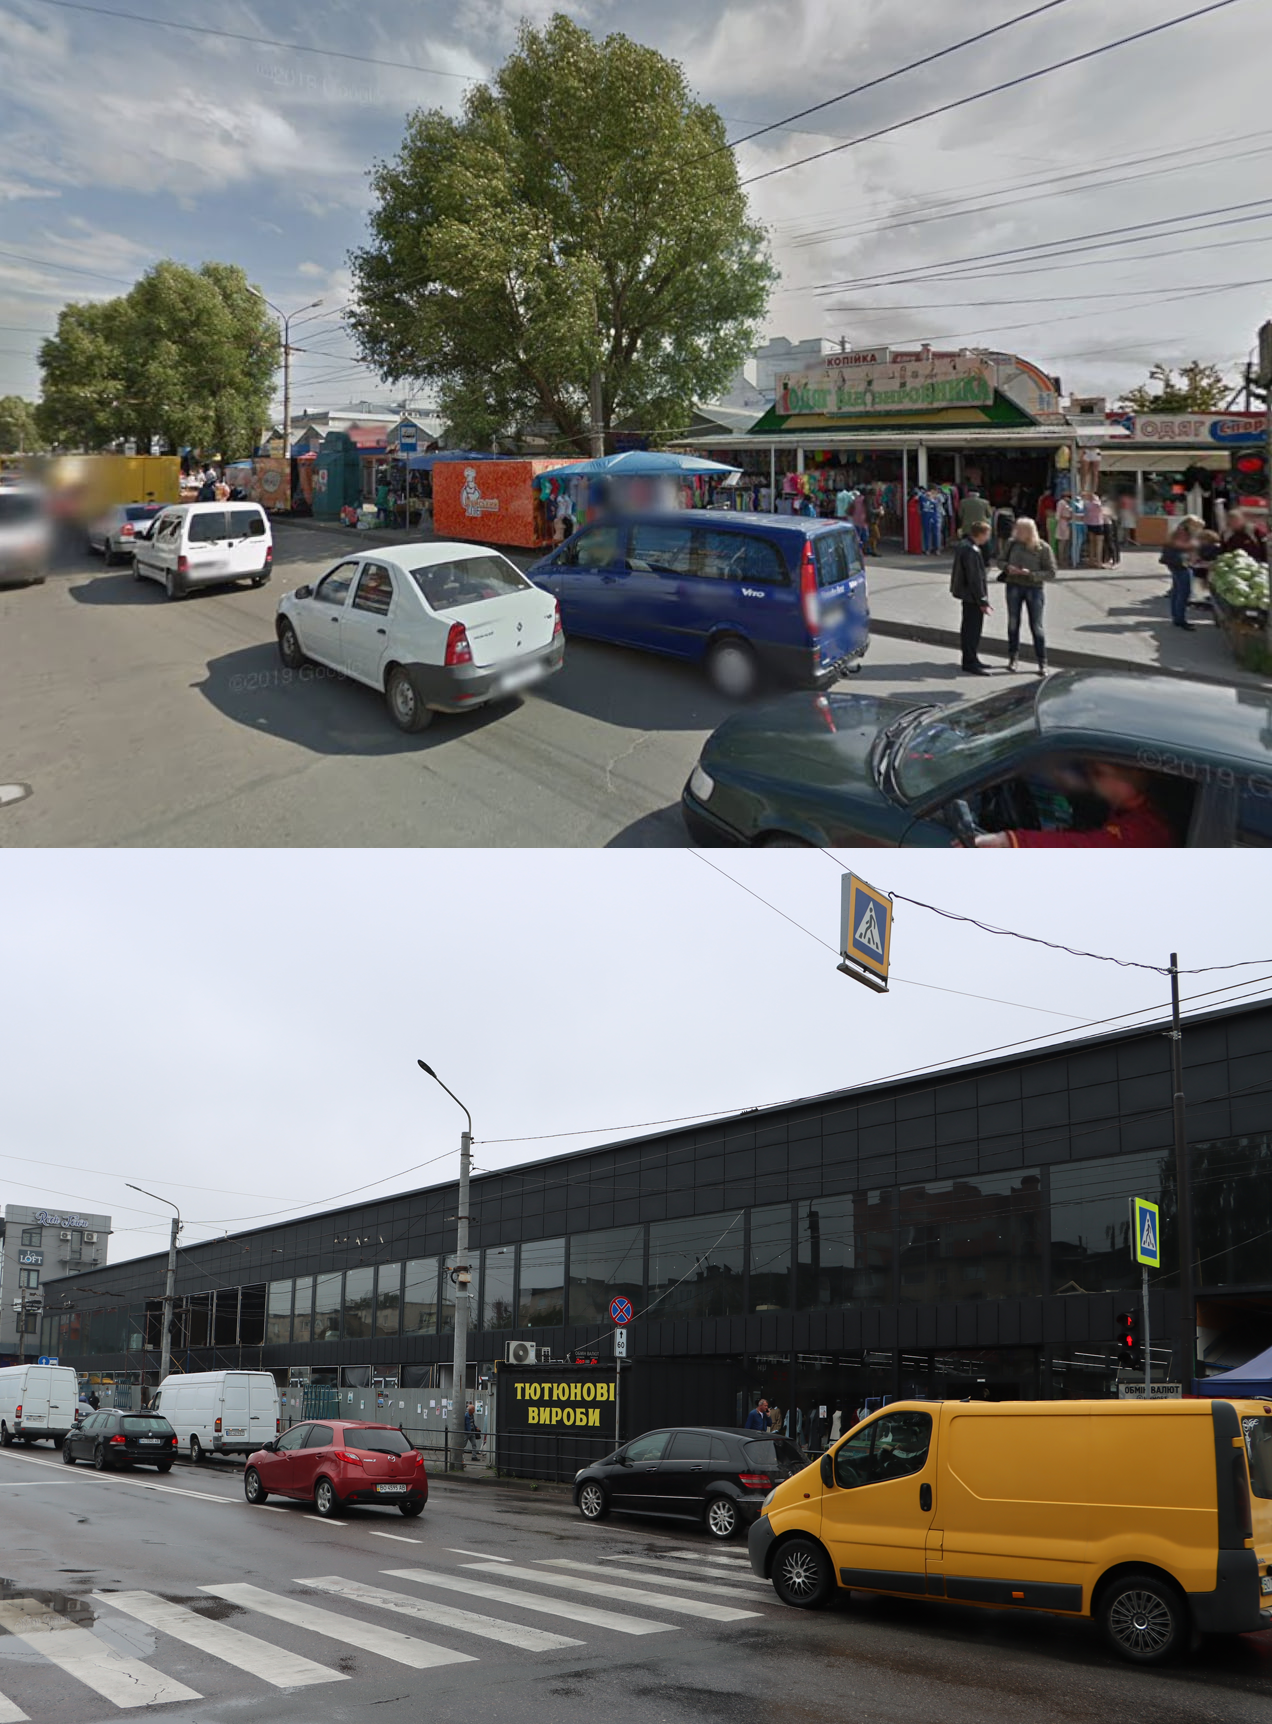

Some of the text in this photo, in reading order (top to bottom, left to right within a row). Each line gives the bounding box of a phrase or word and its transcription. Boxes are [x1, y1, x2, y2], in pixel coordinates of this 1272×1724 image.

[826, 353, 877, 367] КОПІЙКА
[1140, 420, 1205, 440] ОДЯГ
[20, 1254, 42, 1264] LOFT
[617, 1341, 625, 1349] 60
[514, 1382, 615, 1401] ТЮТЮНОВІ
[1150, 1386, 1180, 1394] ВАЛЮТ
[528, 1406, 601, 1426] ВИРОБИ
